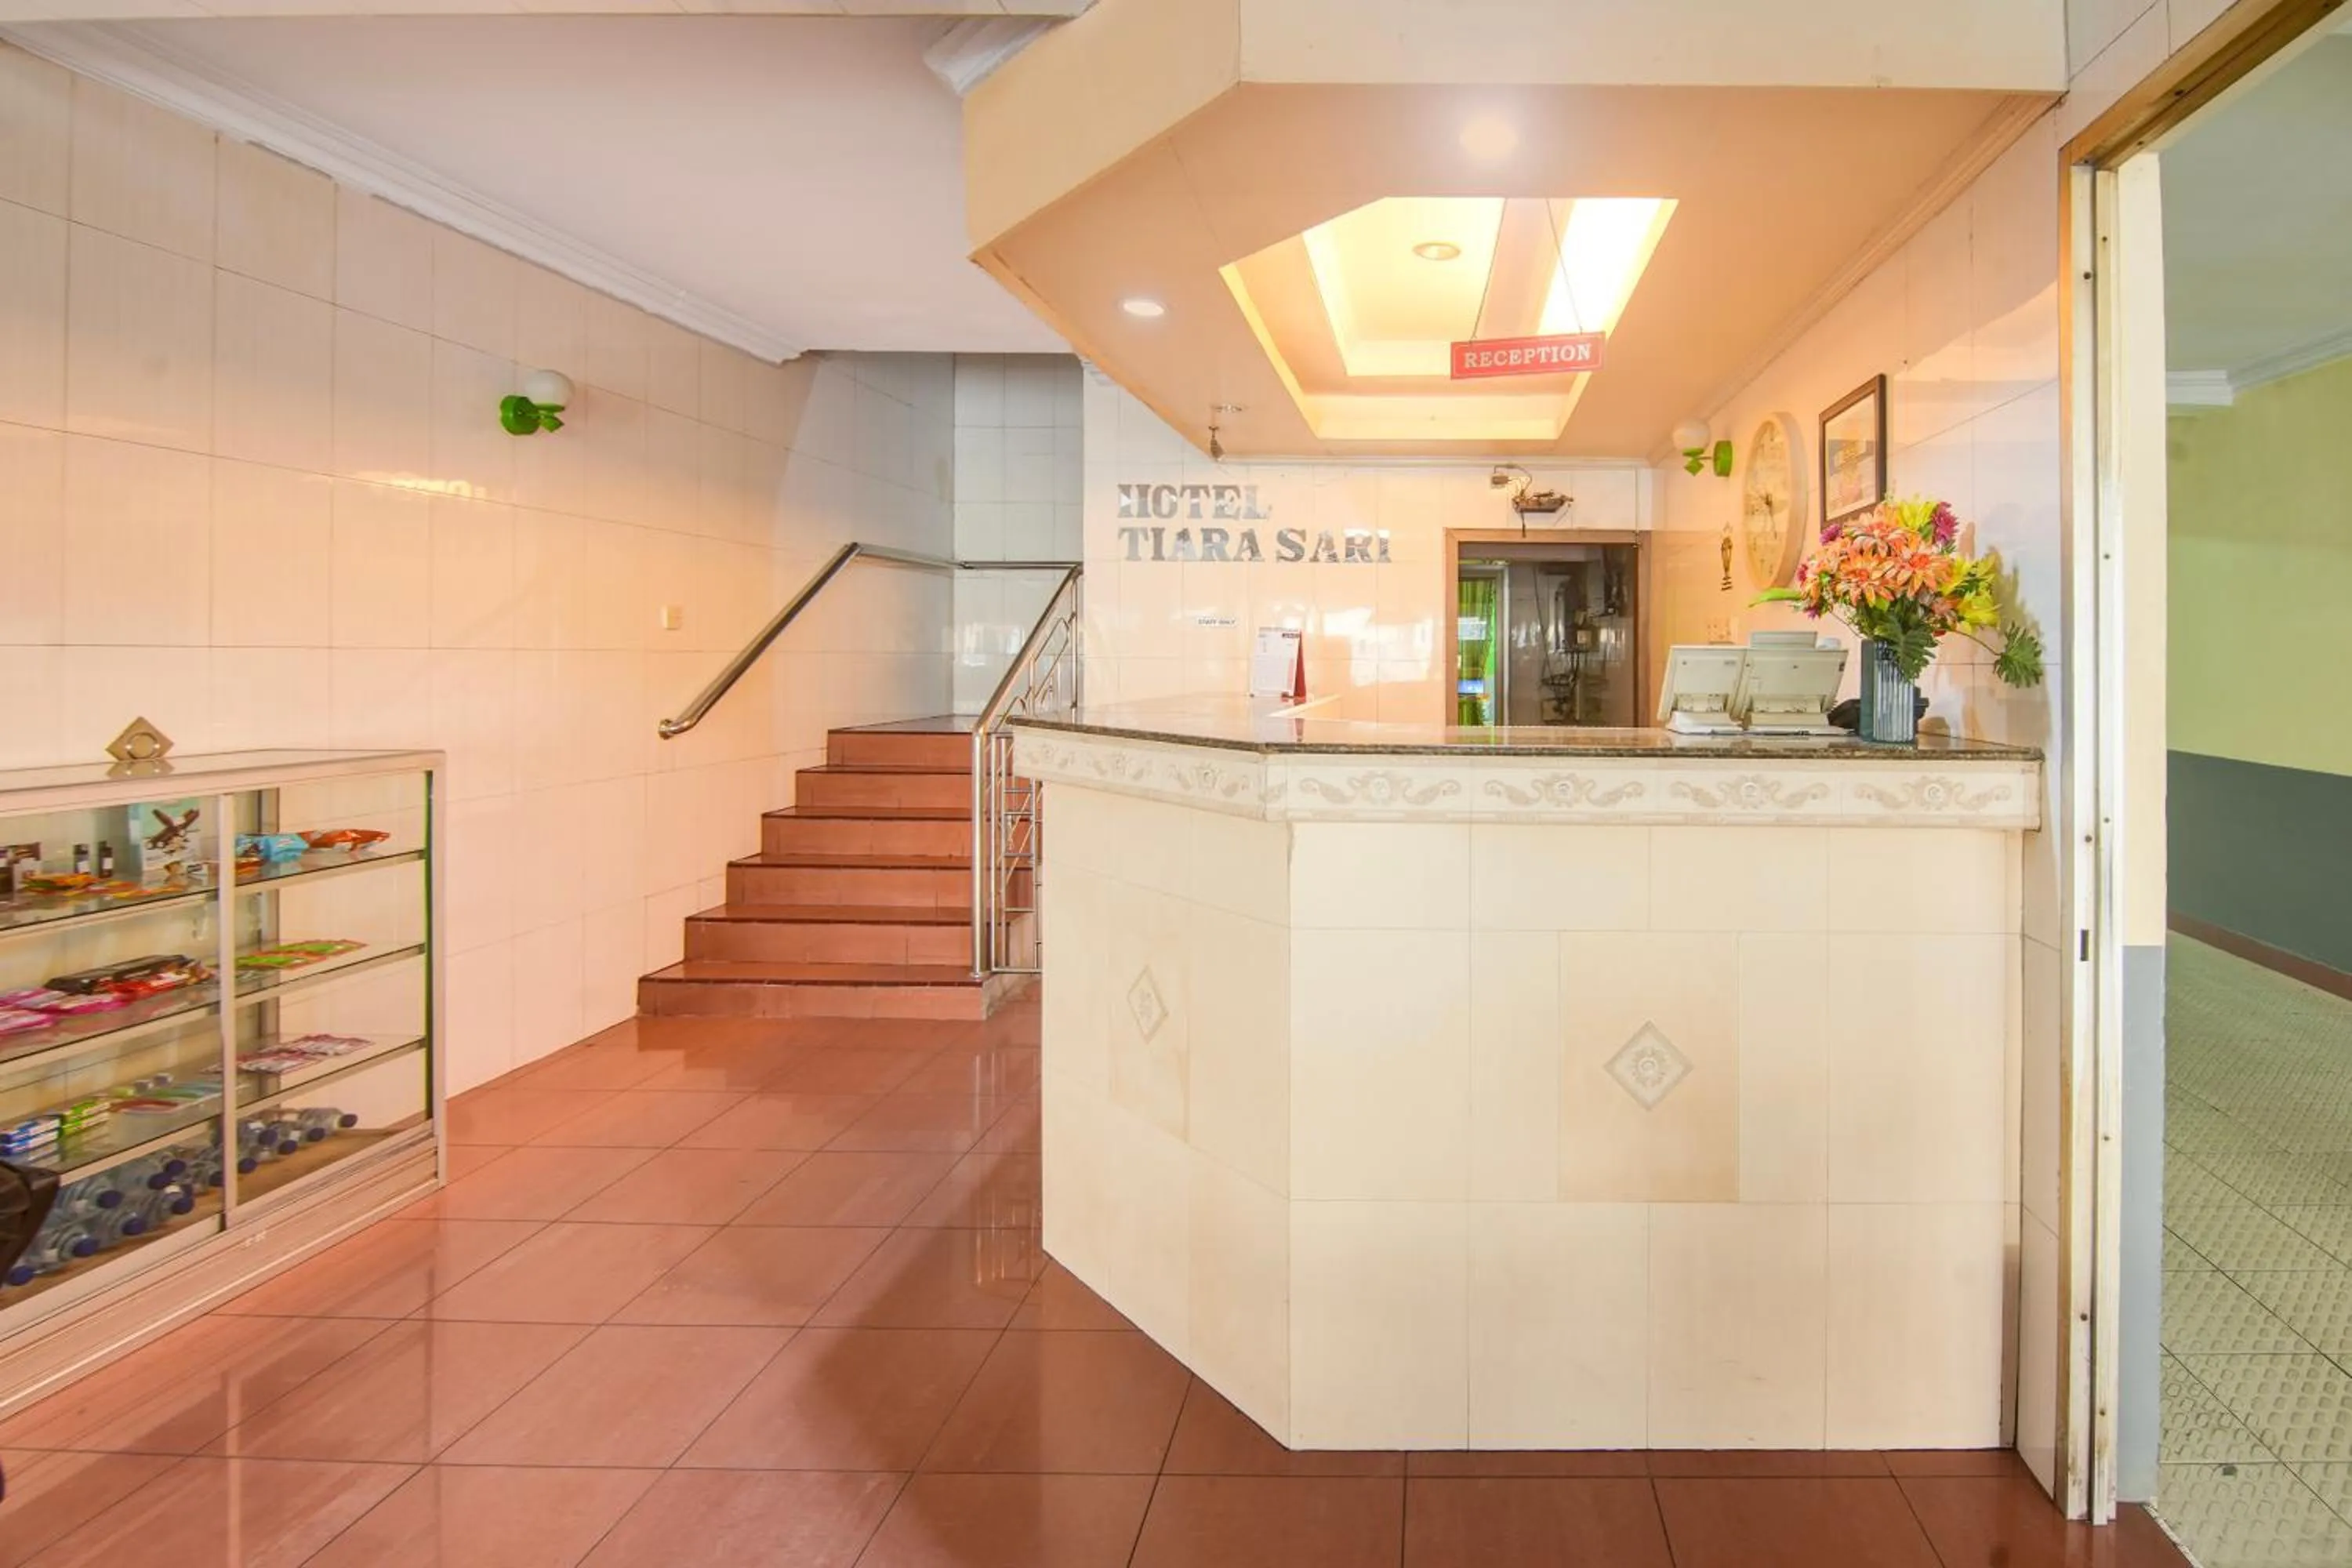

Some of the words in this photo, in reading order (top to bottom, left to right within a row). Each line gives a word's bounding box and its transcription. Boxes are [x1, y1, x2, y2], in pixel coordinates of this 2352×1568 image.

[1464, 343, 1592, 368] RECEPTION
[1117, 484, 1272, 521] HOTEL
[1118, 527, 1265, 562] TIARA
[1276, 527, 1392, 564] SARI
